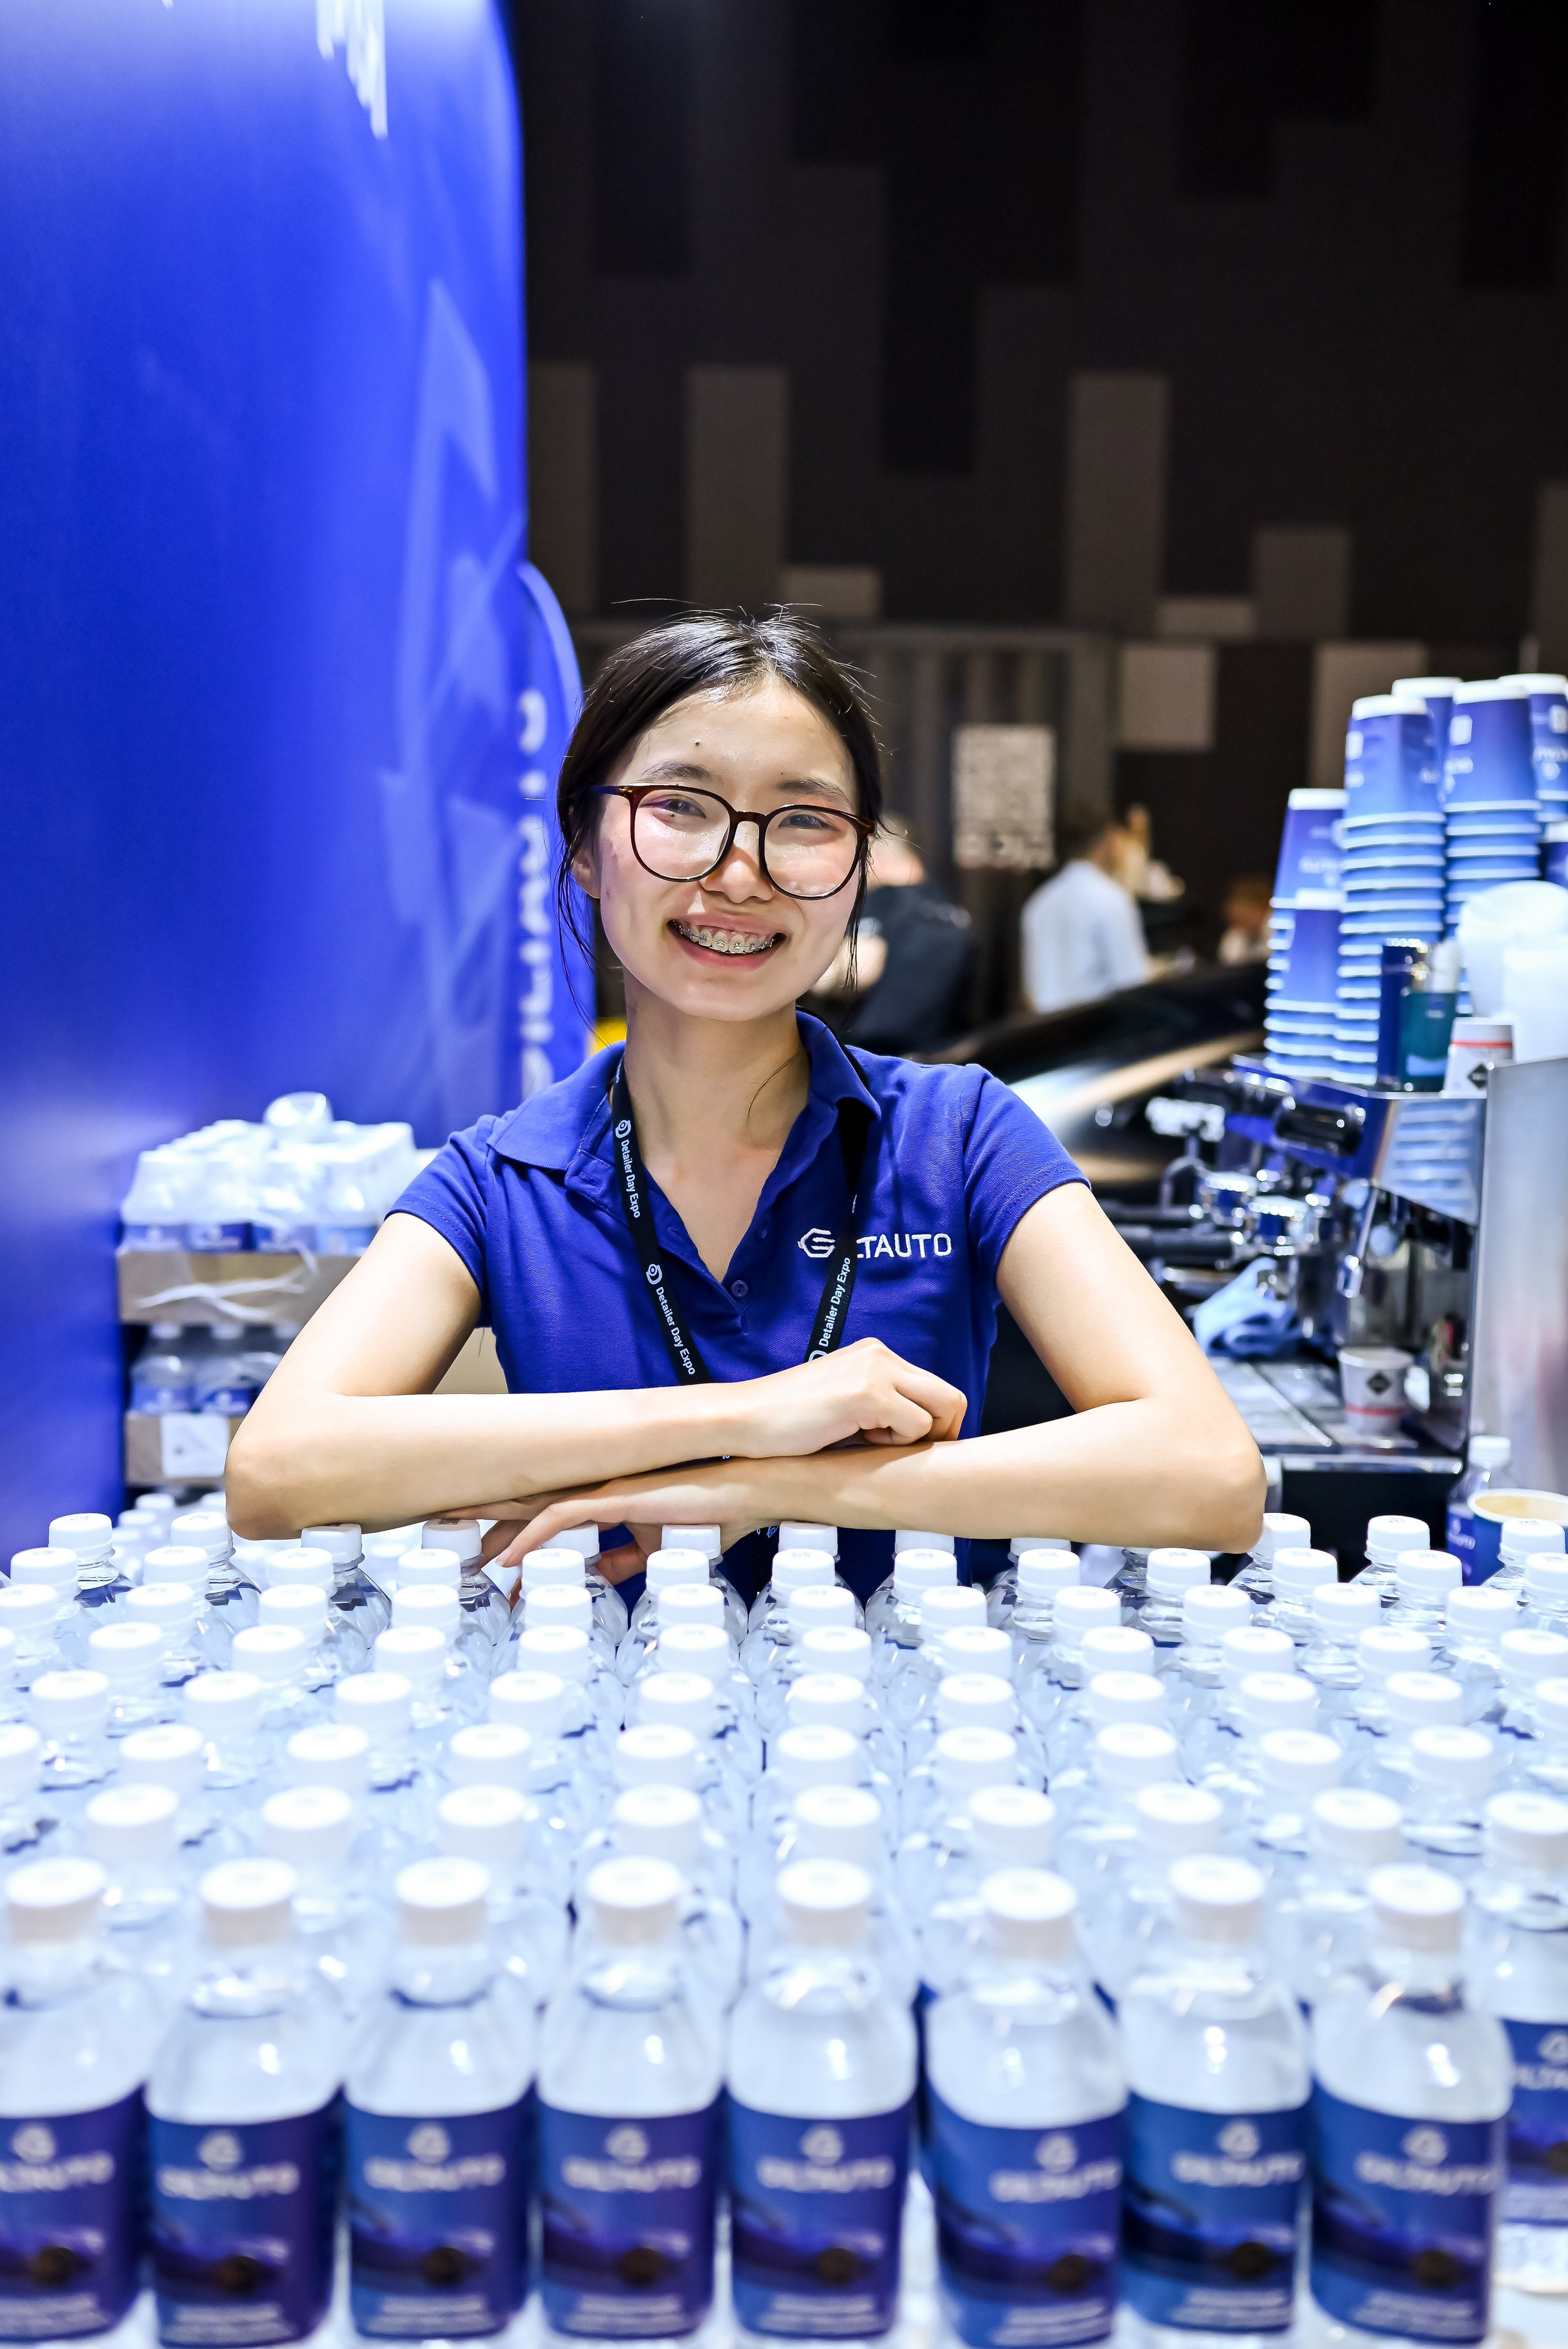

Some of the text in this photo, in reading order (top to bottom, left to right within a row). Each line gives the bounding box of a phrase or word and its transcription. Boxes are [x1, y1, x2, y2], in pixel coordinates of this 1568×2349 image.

[621, 1139, 641, 1218] Detailer Day Expo
[656, 1286, 695, 1375] Detailer Day Expo
[819, 1257, 851, 1348] Detailer Day Expo
